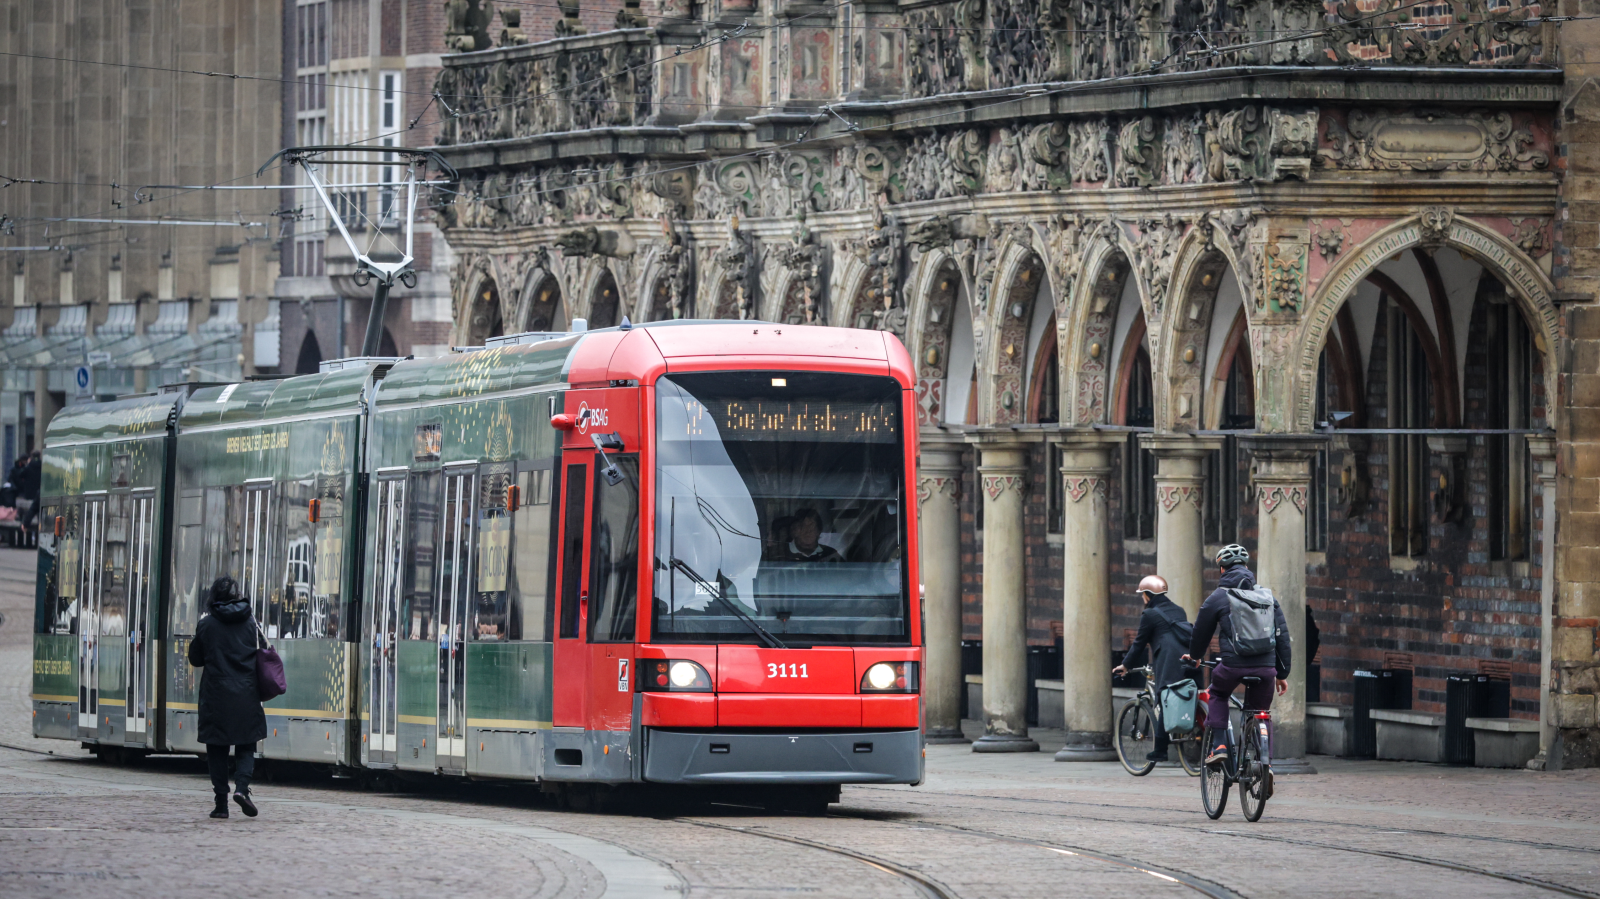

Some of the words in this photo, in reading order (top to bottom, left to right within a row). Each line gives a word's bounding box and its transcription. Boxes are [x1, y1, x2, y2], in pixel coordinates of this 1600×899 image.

[591, 408, 609, 427] BSAG
[481, 545, 507, 582] JACOBS
[767, 662, 809, 678] 3111
[618, 681, 628, 691] VBN
